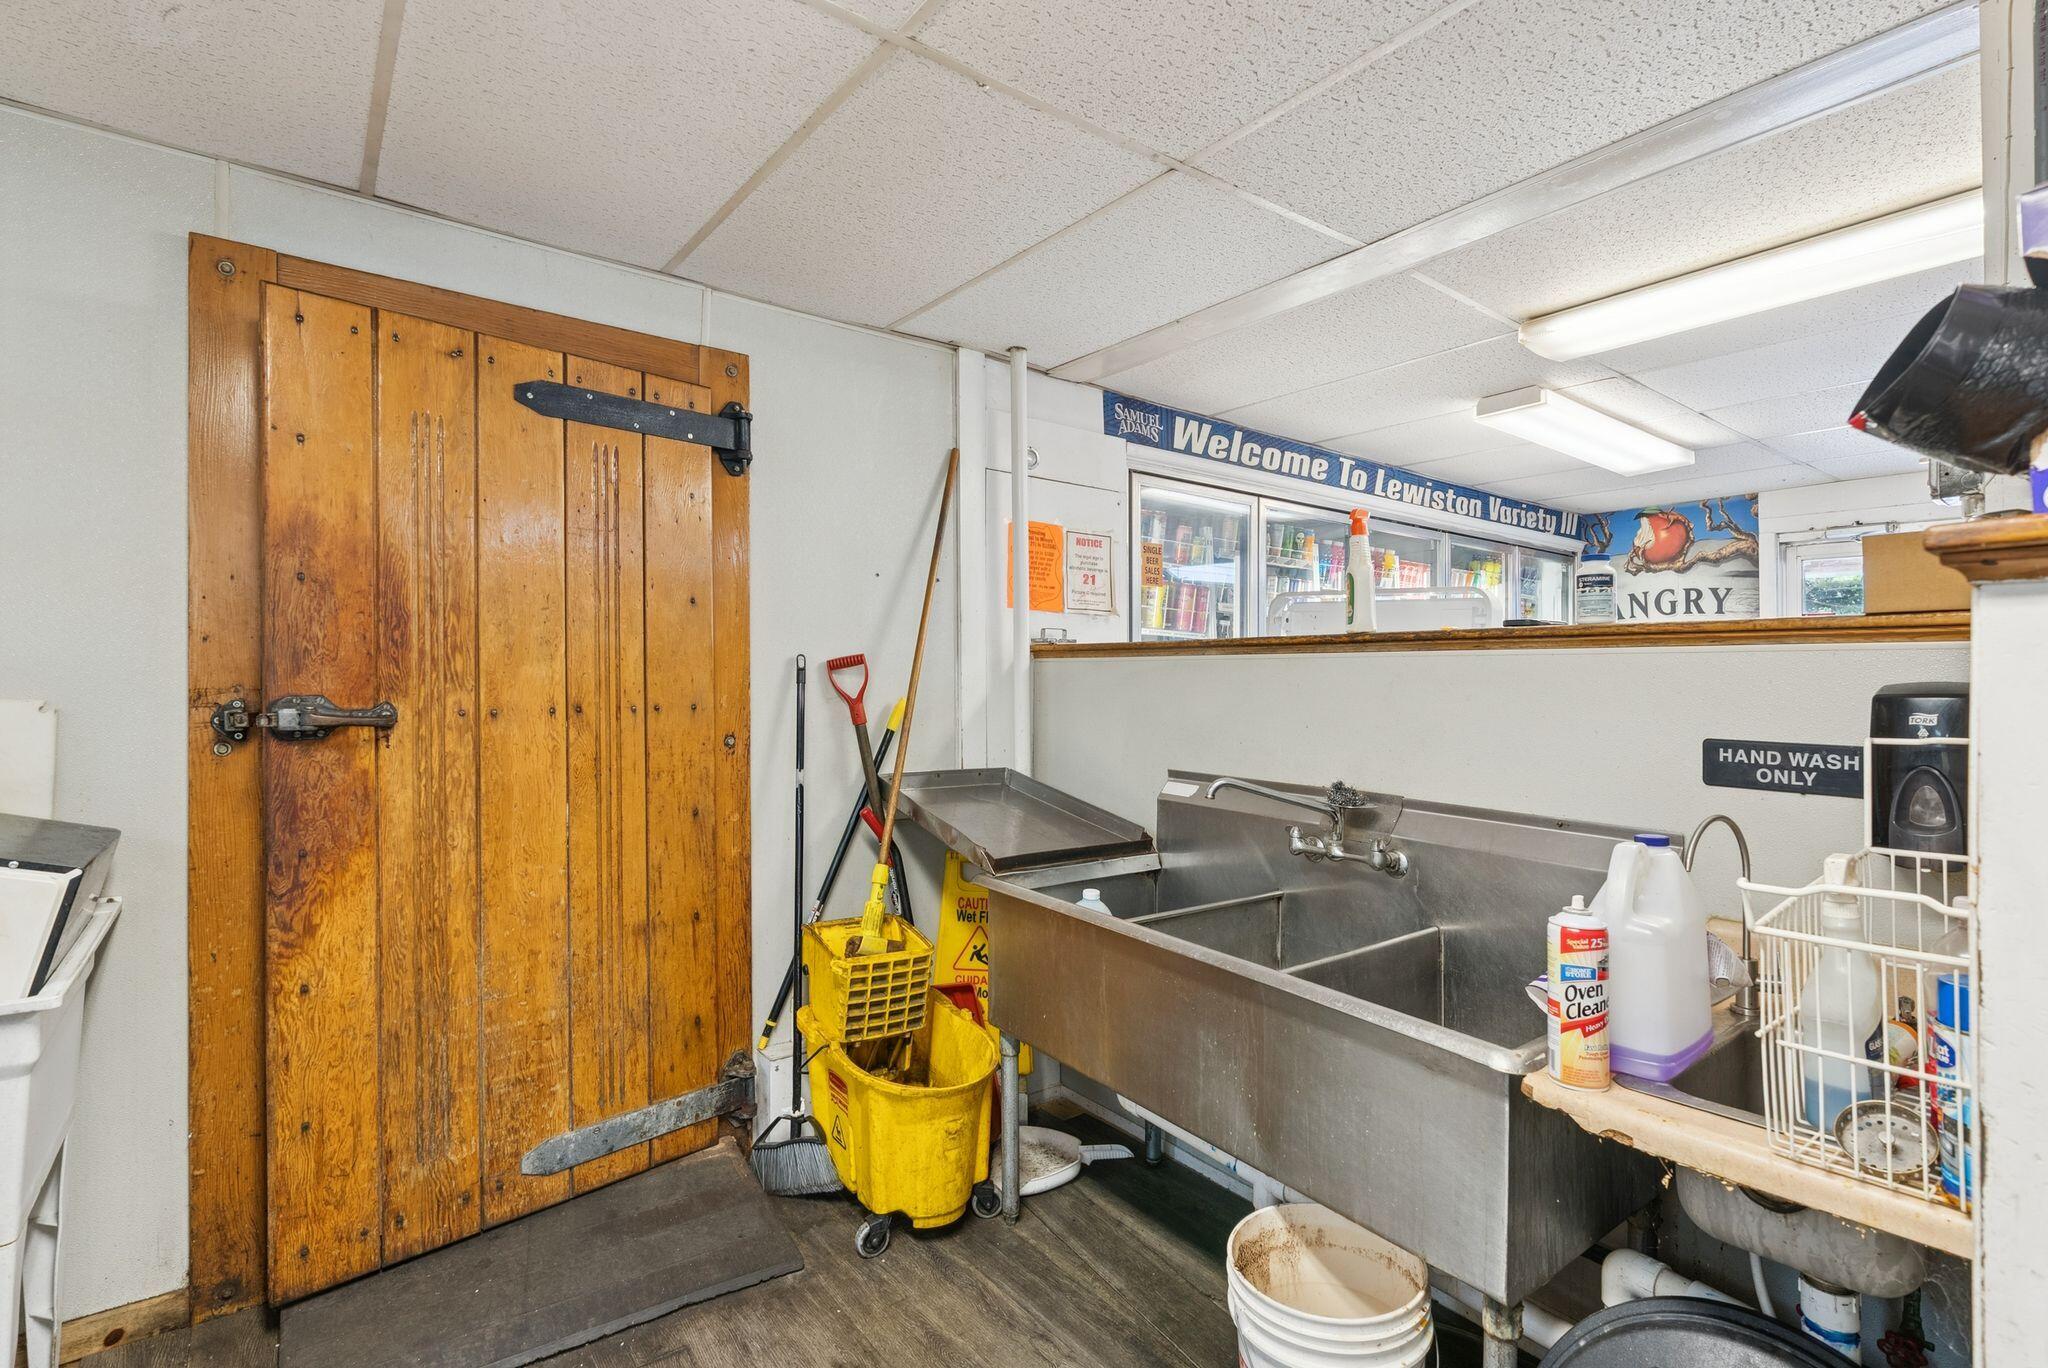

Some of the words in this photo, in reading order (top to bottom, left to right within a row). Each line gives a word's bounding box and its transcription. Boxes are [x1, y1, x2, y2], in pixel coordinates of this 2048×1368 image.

[1114, 402, 1163, 430] SAMUEL
[1118, 419, 1160, 443] ADAMS
[1173, 415, 1329, 480] Welcome
[1339, 457, 1368, 491] To
[1374, 468, 1482, 519] Lewiston
[1488, 496, 1557, 534] Variety
[1075, 536, 1103, 549] NOTICE
[1142, 545, 1162, 555] SINGLE
[1146, 556, 1159, 565] BEER
[1145, 566, 1160, 576] SALES
[1083, 573, 1096, 586] 21
[1145, 576, 1159, 584] HERE
[1909, 716, 1936, 725] TORK
[1719, 748, 1782, 767] HAND
[1788, 751, 1860, 771] WASH
[1755, 768, 1817, 786] ONLY
[957, 897, 989, 910] CAUTI
[956, 909, 977, 923] Wet
[954, 974, 988, 985] CUIDA
[1565, 984, 1603, 1002] Oven
[1585, 1020, 1604, 1033] Heavy
